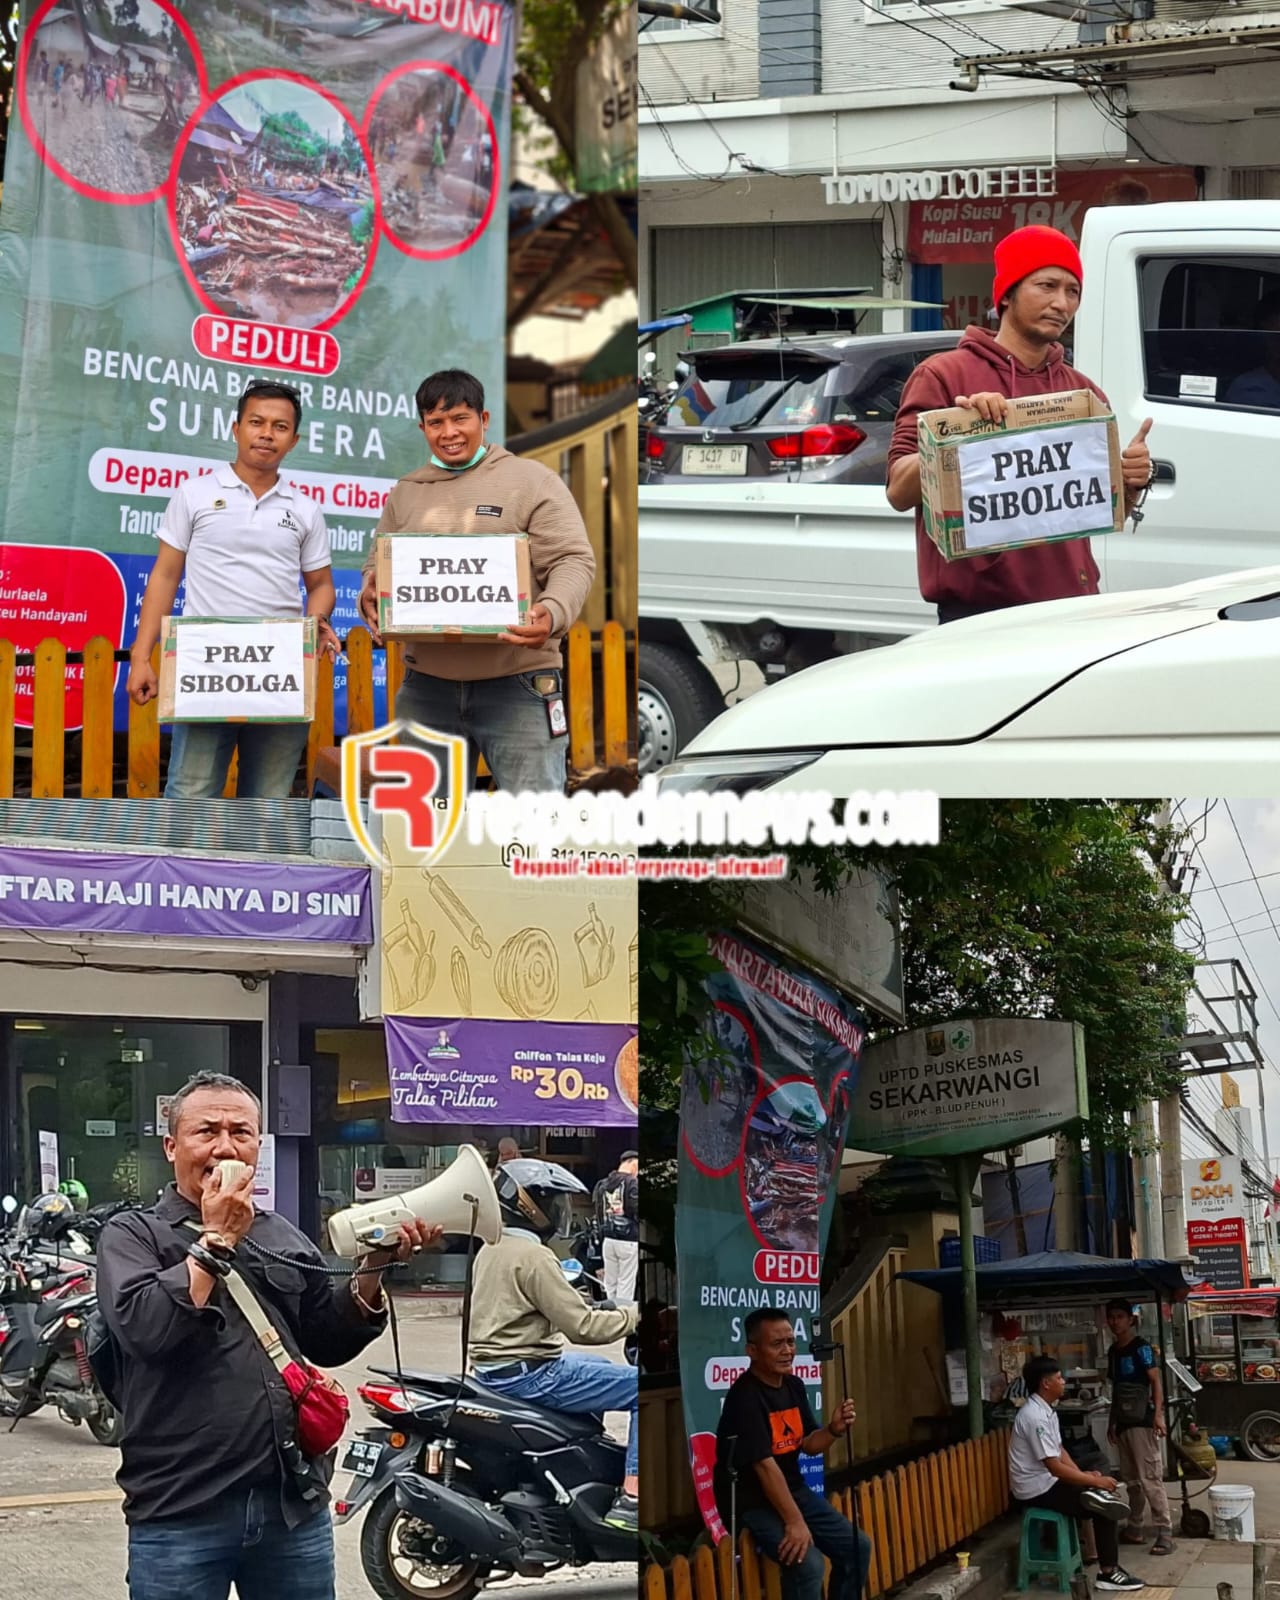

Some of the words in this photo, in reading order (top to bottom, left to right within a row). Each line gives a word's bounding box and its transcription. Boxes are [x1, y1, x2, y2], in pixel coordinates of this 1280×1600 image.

[821, 169, 942, 205] TOMORO
[946, 165, 1057, 201] COFFEE
[922, 204, 960, 223] Kopi
[960, 202, 1001, 220] Susu
[922, 229, 961, 244] Mulai
[963, 227, 993, 243] Dari
[210, 320, 326, 369] PEDULI
[83, 346, 218, 394] BENCANA
[936, 420, 950, 437] 2
[991, 441, 1073, 482] PRAY
[967, 476, 1106, 524] SIBOLGA
[419, 557, 488, 575] PRAY
[396, 585, 514, 603] SIBOLGA
[20, 607, 88, 625] Handayani
[204, 645, 275, 664] PRAY
[180, 674, 300, 693] SIBOLGA
[82, 879, 153, 907] HAJI
[159, 883, 265, 913] HANYA
[271, 890, 300, 914] DI
[306, 893, 361, 917] SINI
[708, 935, 818, 1017] WARTAWAN
[513, 1050, 553, 1062] Chiffon
[556, 1051, 582, 1062] Talas
[583, 1052, 606, 1064] Keju
[879, 1066, 919, 1085] UPTD
[924, 1050, 1024, 1078] PUSKESMAS
[391, 1063, 449, 1089] Lembutnya
[449, 1070, 498, 1085] Citarasa
[393, 1083, 437, 1107] Talas
[440, 1084, 498, 1108] Pilihan
[869, 1066, 1040, 1111] SEKARWANGI
[907, 1108, 928, 1119] PPK
[935, 1103, 962, 1115] BLUD
[964, 1098, 999, 1111] PENUH
[545, 1127, 565, 1138] PICK
[566, 1127, 577, 1138] UP
[1191, 1184, 1233, 1200] DKH
[1220, 1223, 1239, 1232] JAM
[765, 1254, 819, 1279] PEDU
[701, 1286, 771, 1308] BENCANA
